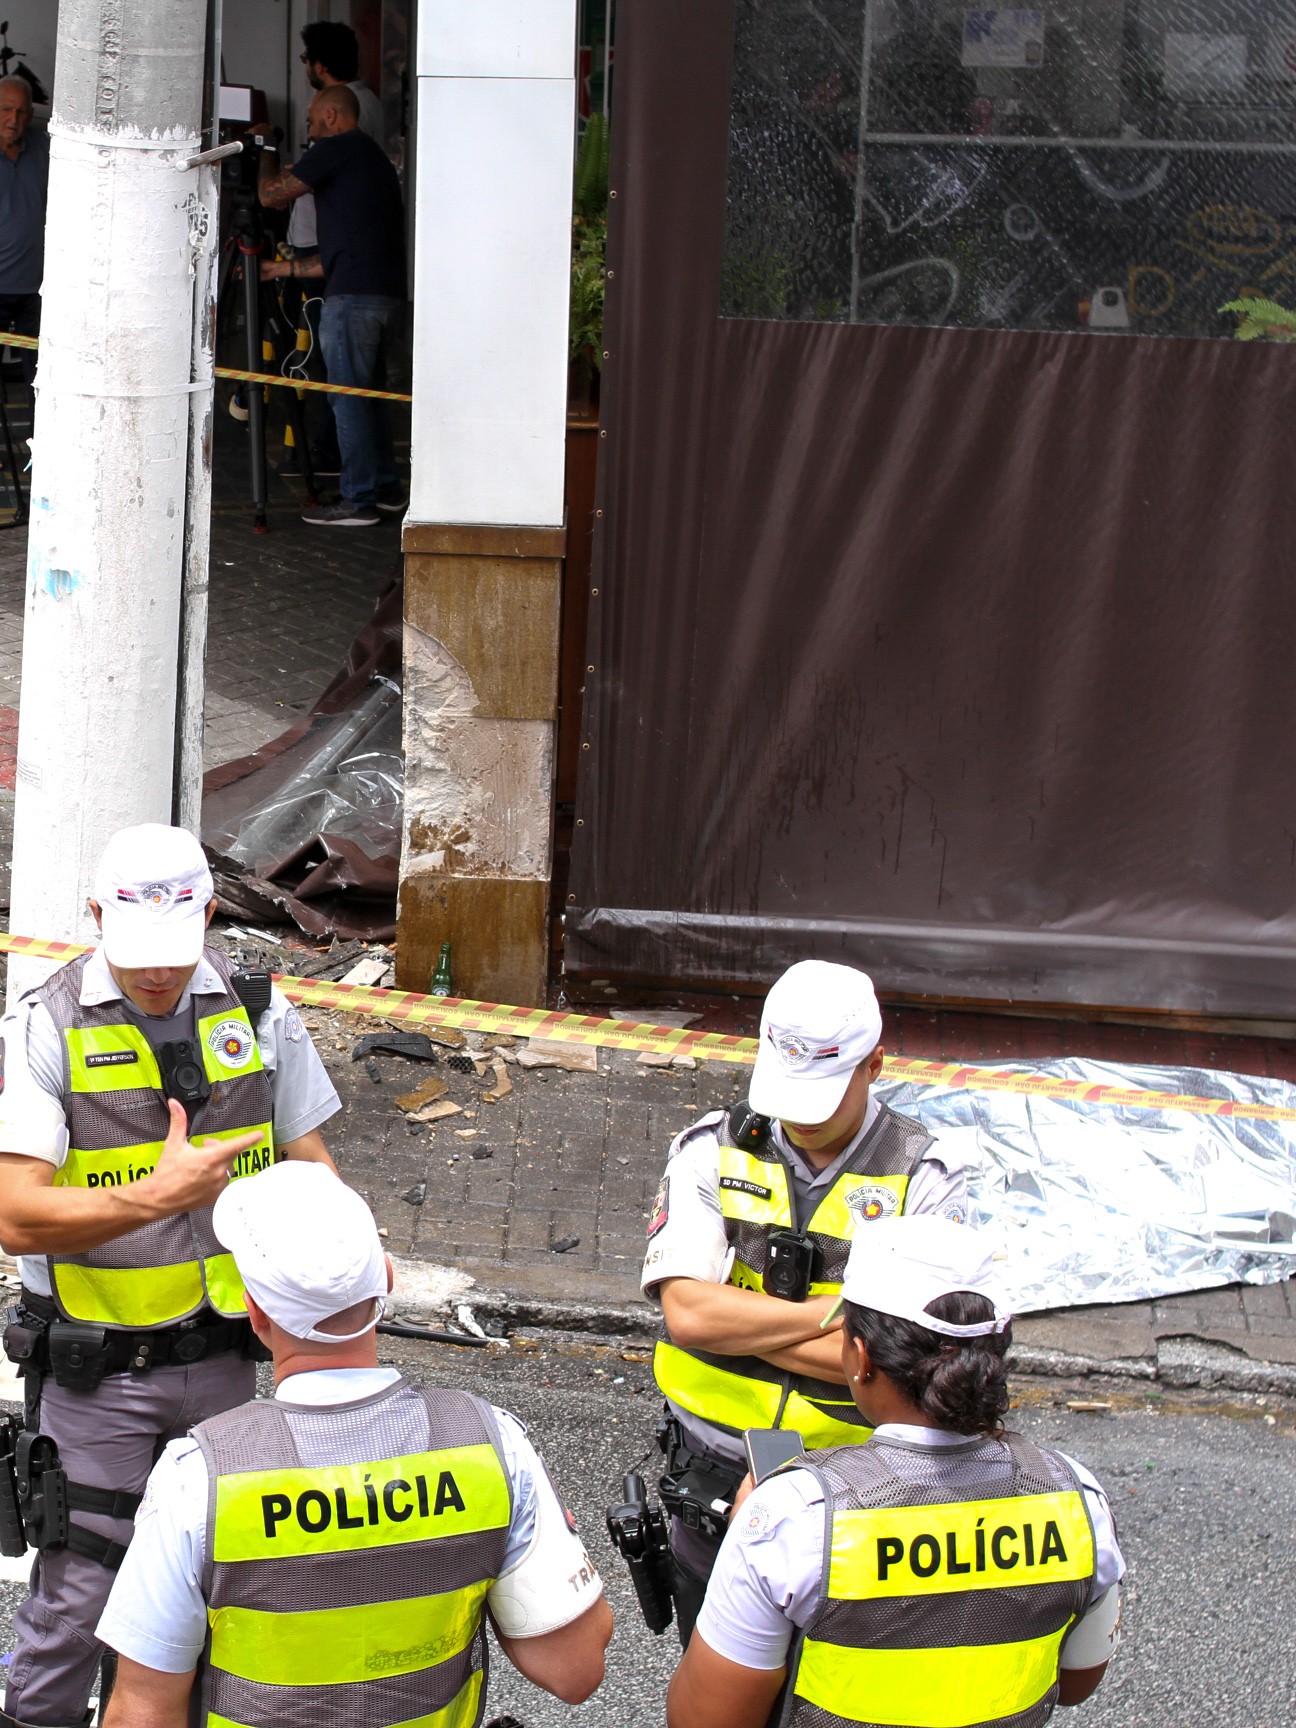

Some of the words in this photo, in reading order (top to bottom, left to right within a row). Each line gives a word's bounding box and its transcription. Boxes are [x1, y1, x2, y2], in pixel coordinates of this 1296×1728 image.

[211, 1025, 226, 1046] POLÍCIA
[228, 1023, 252, 1038] MILITAR
[744, 1182, 767, 1195] VICTOR
[848, 1187, 873, 1202] POLÍCIA
[875, 1188, 896, 1204] MILITAR
[260, 1470, 467, 1538] POLÍCIA
[876, 1516, 1069, 1582] POLÍCIA
